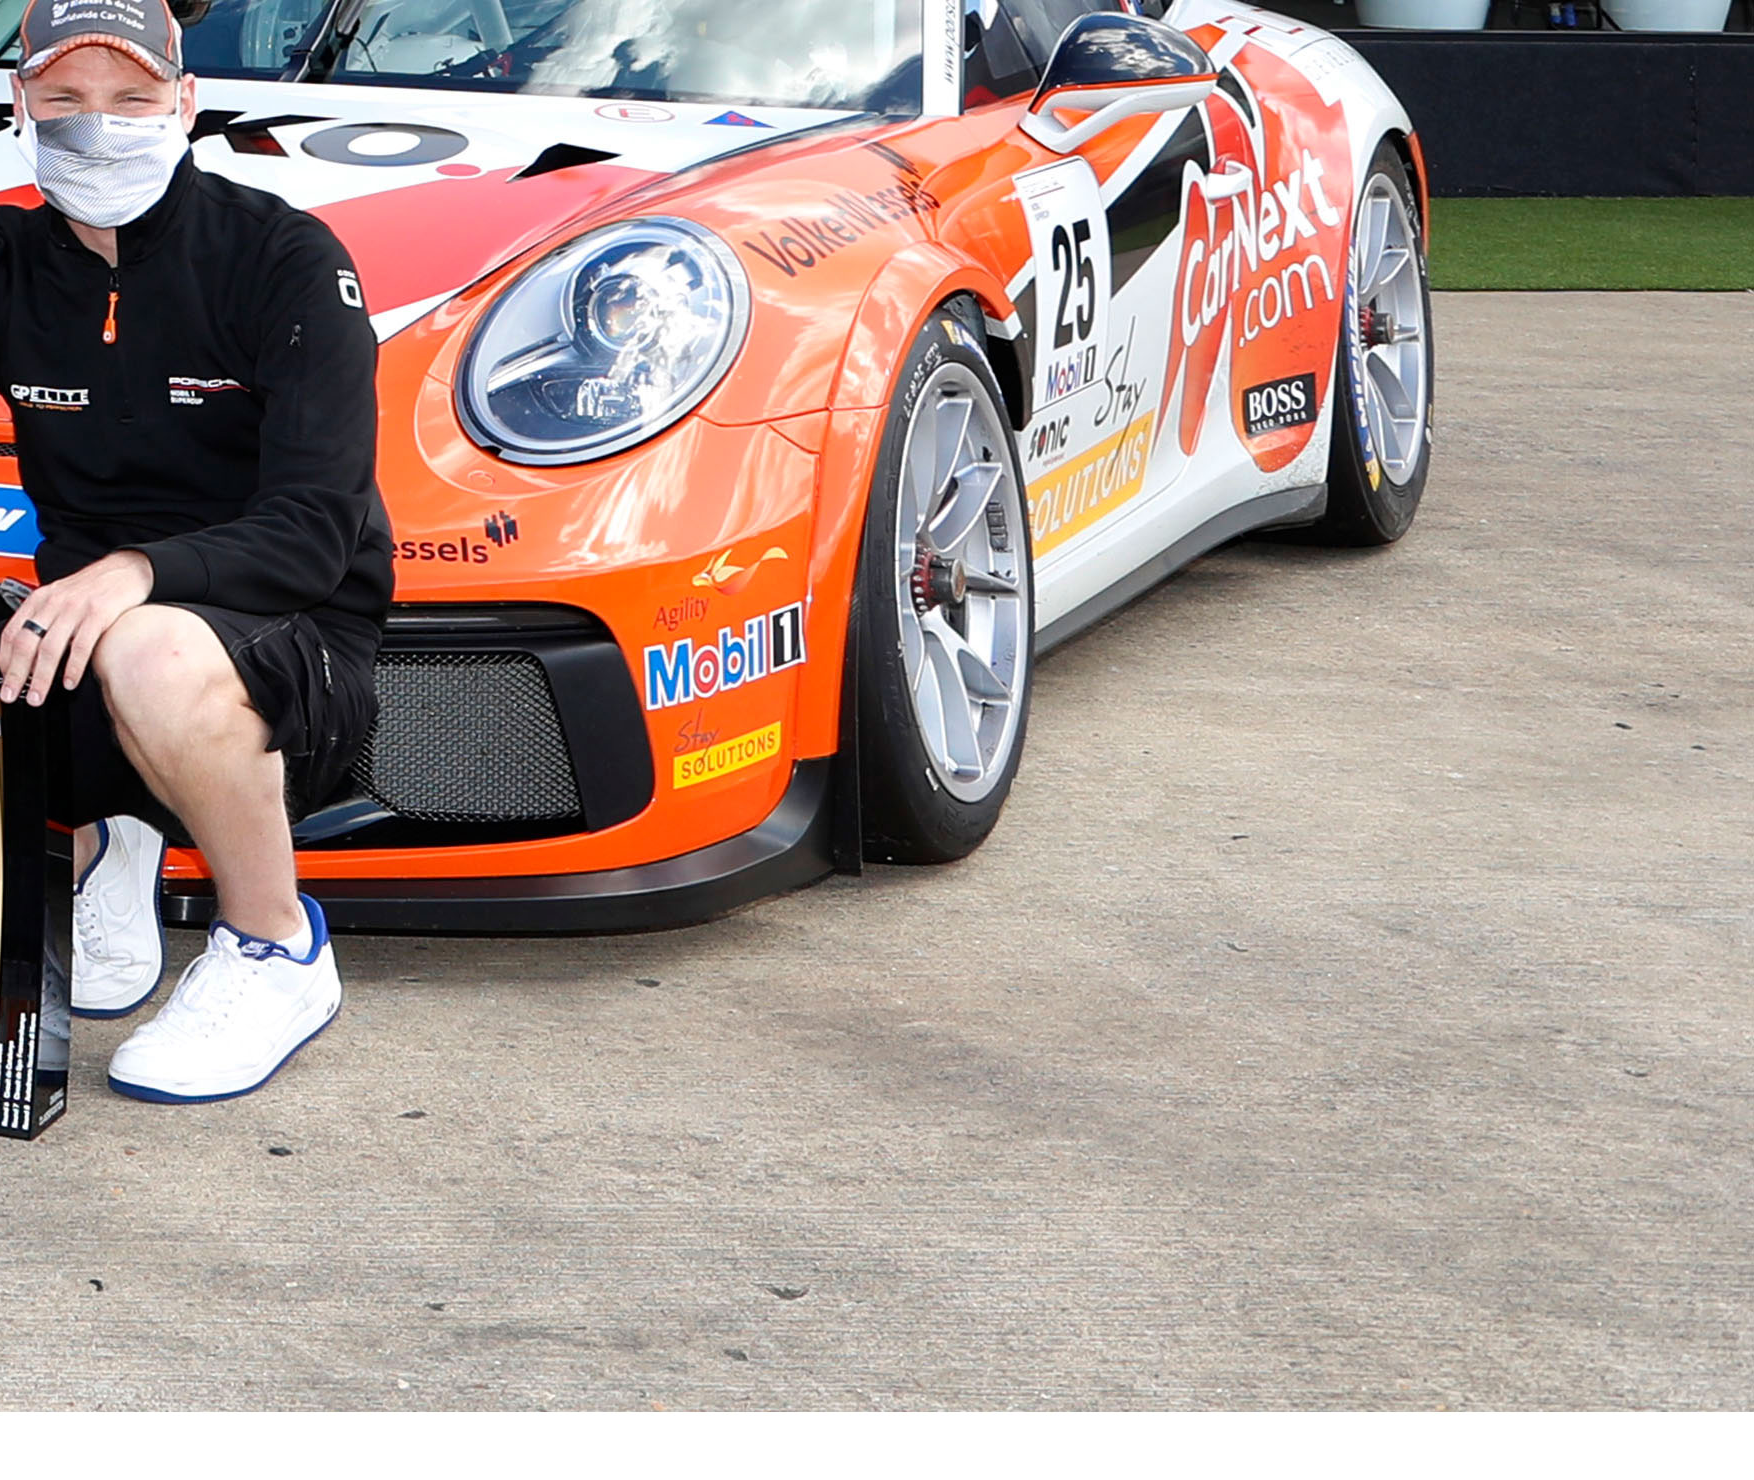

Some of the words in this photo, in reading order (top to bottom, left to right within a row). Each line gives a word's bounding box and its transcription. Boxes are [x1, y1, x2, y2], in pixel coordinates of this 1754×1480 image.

[99, 9, 116, 21] Car
[1182, 148, 1340, 348] CarNext
[1051, 218, 1096, 351] 25
[1238, 252, 1335, 348] .com
[1045, 350, 1083, 403] Mobil
[1247, 381, 1307, 422] BOSS
[652, 595, 711, 633] Agility
[642, 621, 768, 710] Mobil
[679, 730, 778, 783] SOLUTIONS
